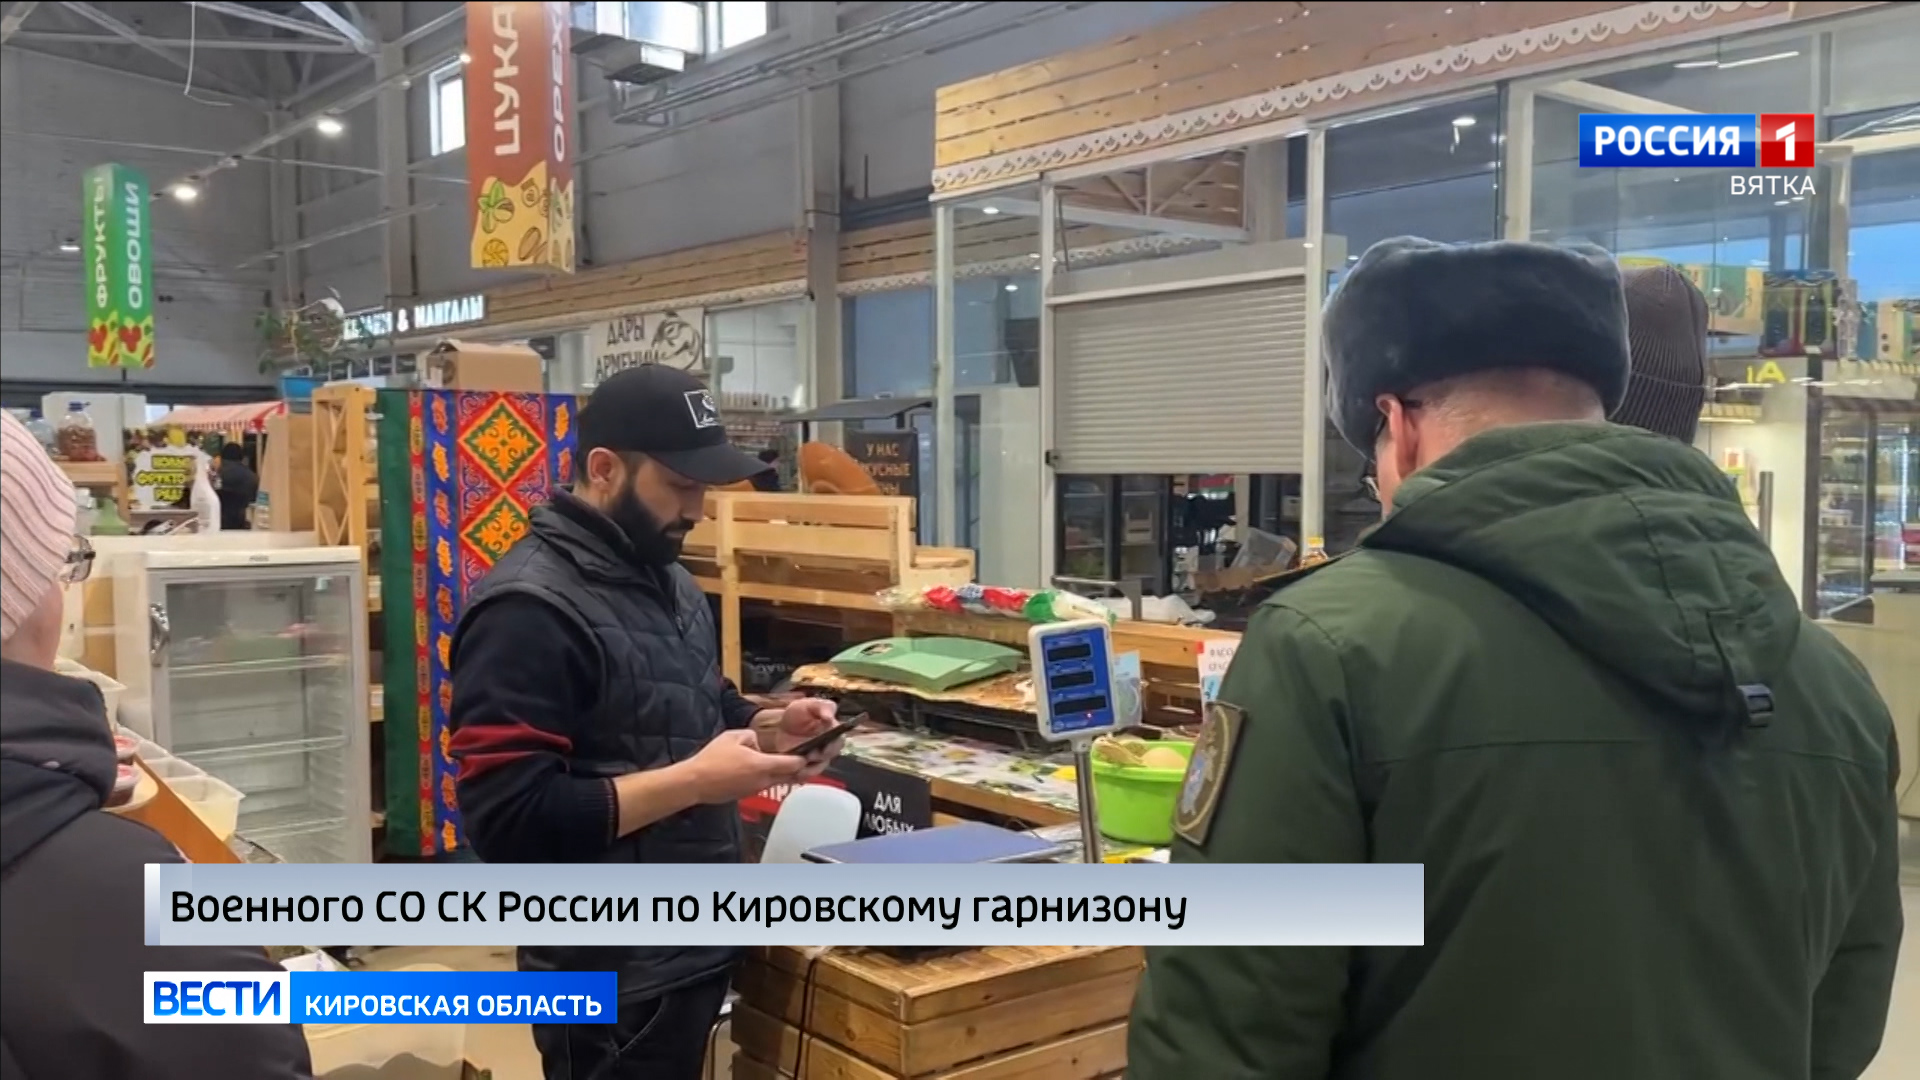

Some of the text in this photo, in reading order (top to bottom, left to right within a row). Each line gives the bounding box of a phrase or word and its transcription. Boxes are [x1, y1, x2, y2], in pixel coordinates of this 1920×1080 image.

[93, 176, 108, 309] ФРУКТЫ
[125, 181, 143, 310] ОВОЩИ
[606, 316, 645, 346] ДАРЫ
[873, 791, 902, 814] ДЛЯ
